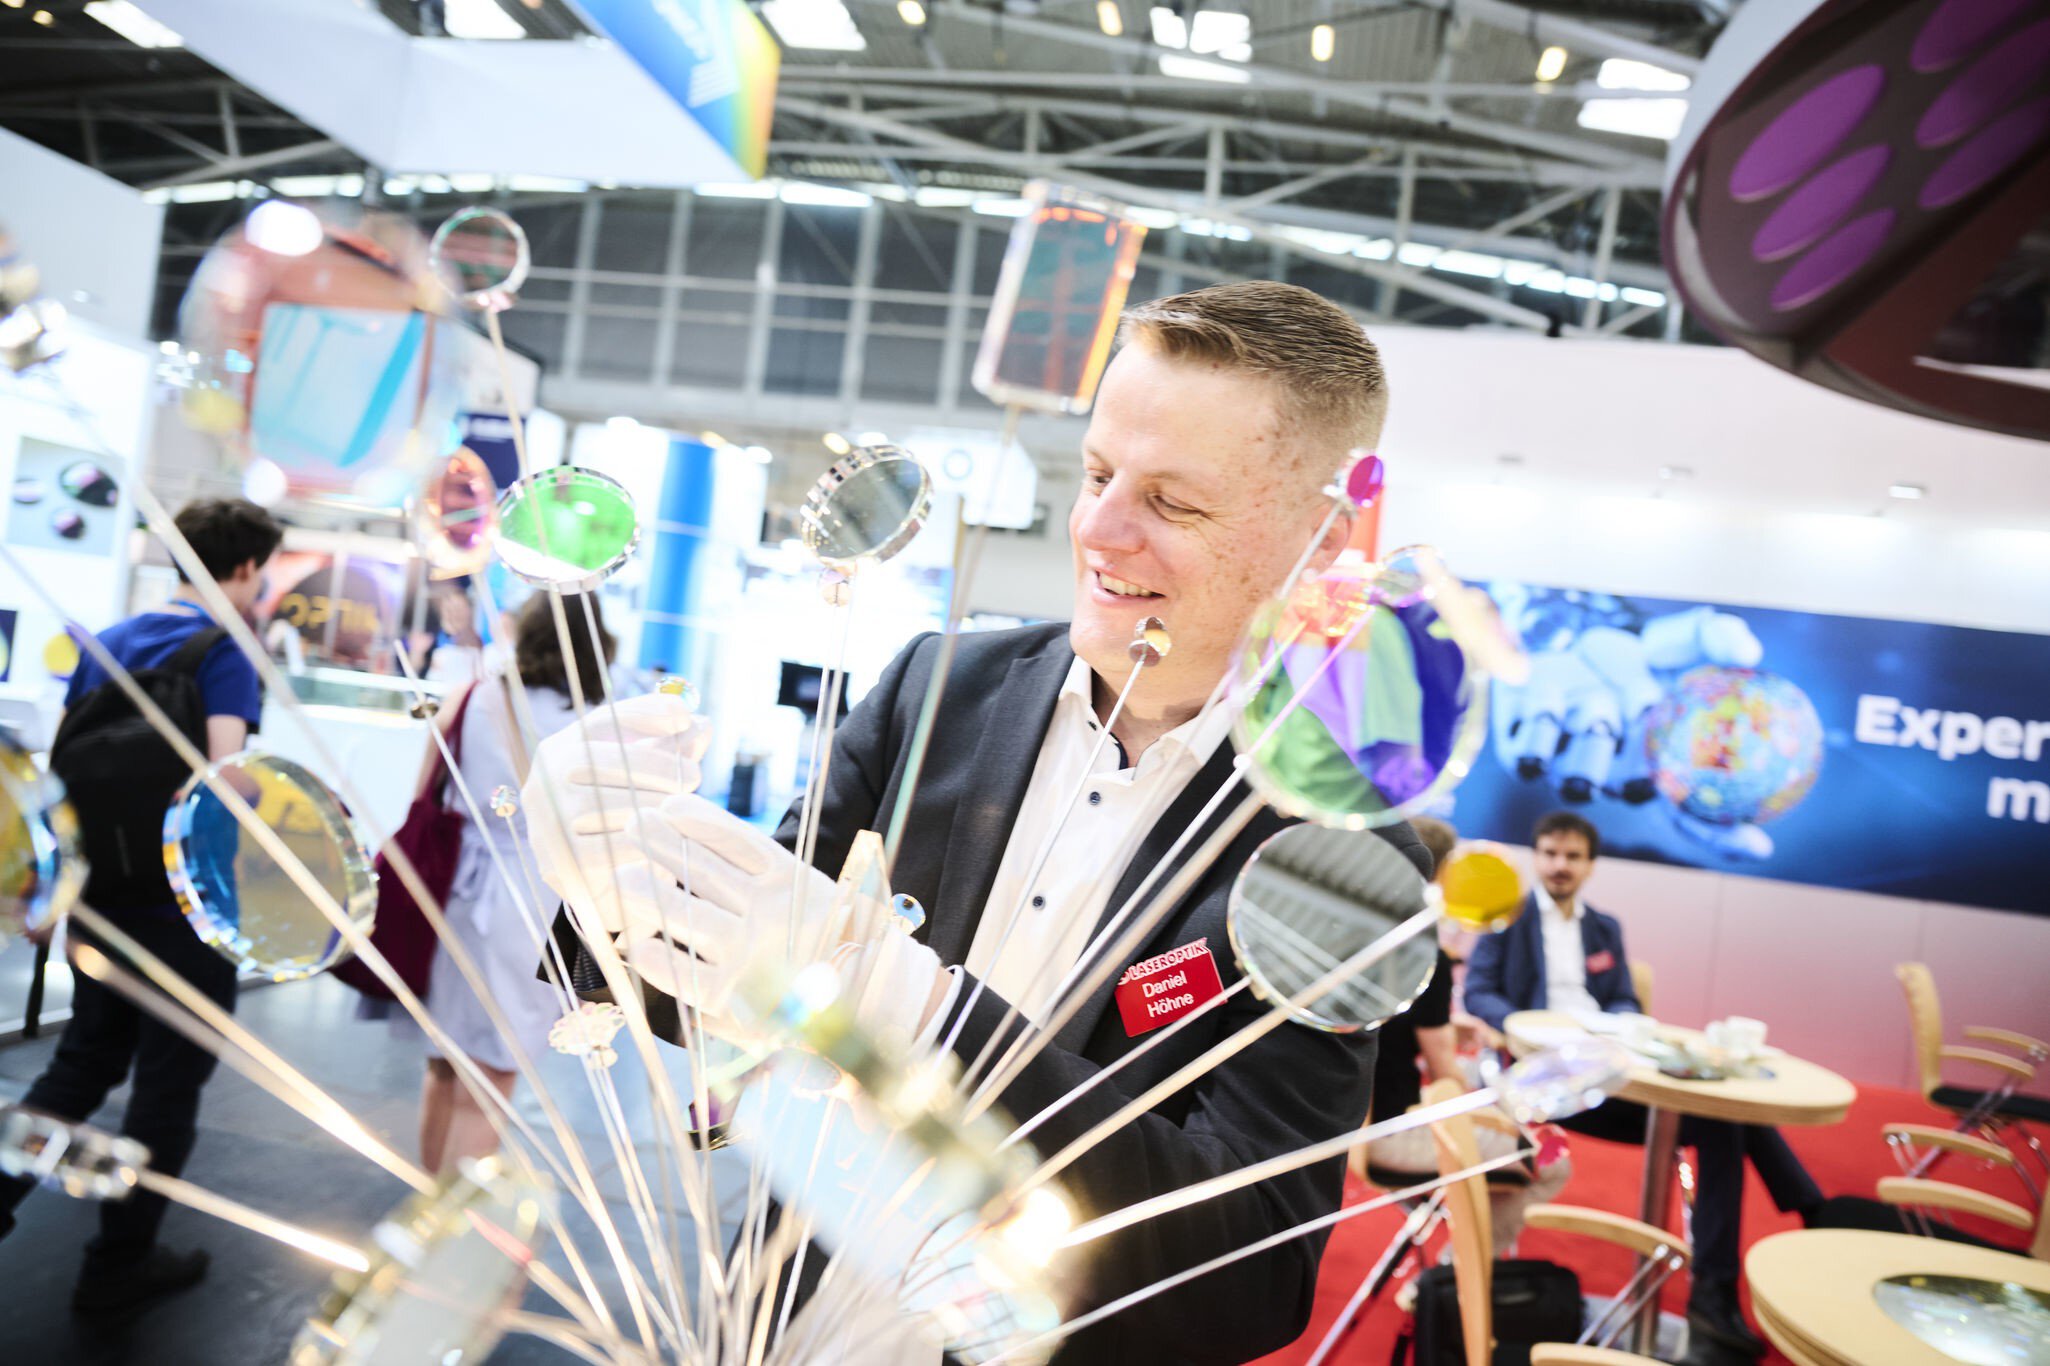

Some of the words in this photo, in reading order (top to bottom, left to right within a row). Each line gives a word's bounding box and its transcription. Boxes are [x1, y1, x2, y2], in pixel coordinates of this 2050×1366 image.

[1855, 694, 2050, 761] Exper
[1987, 776, 2050, 824] m
[1128, 942, 1207, 980] LASEROPTIK
[1142, 970, 1188, 998] Daniel
[1147, 993, 1194, 1018] Höhne
